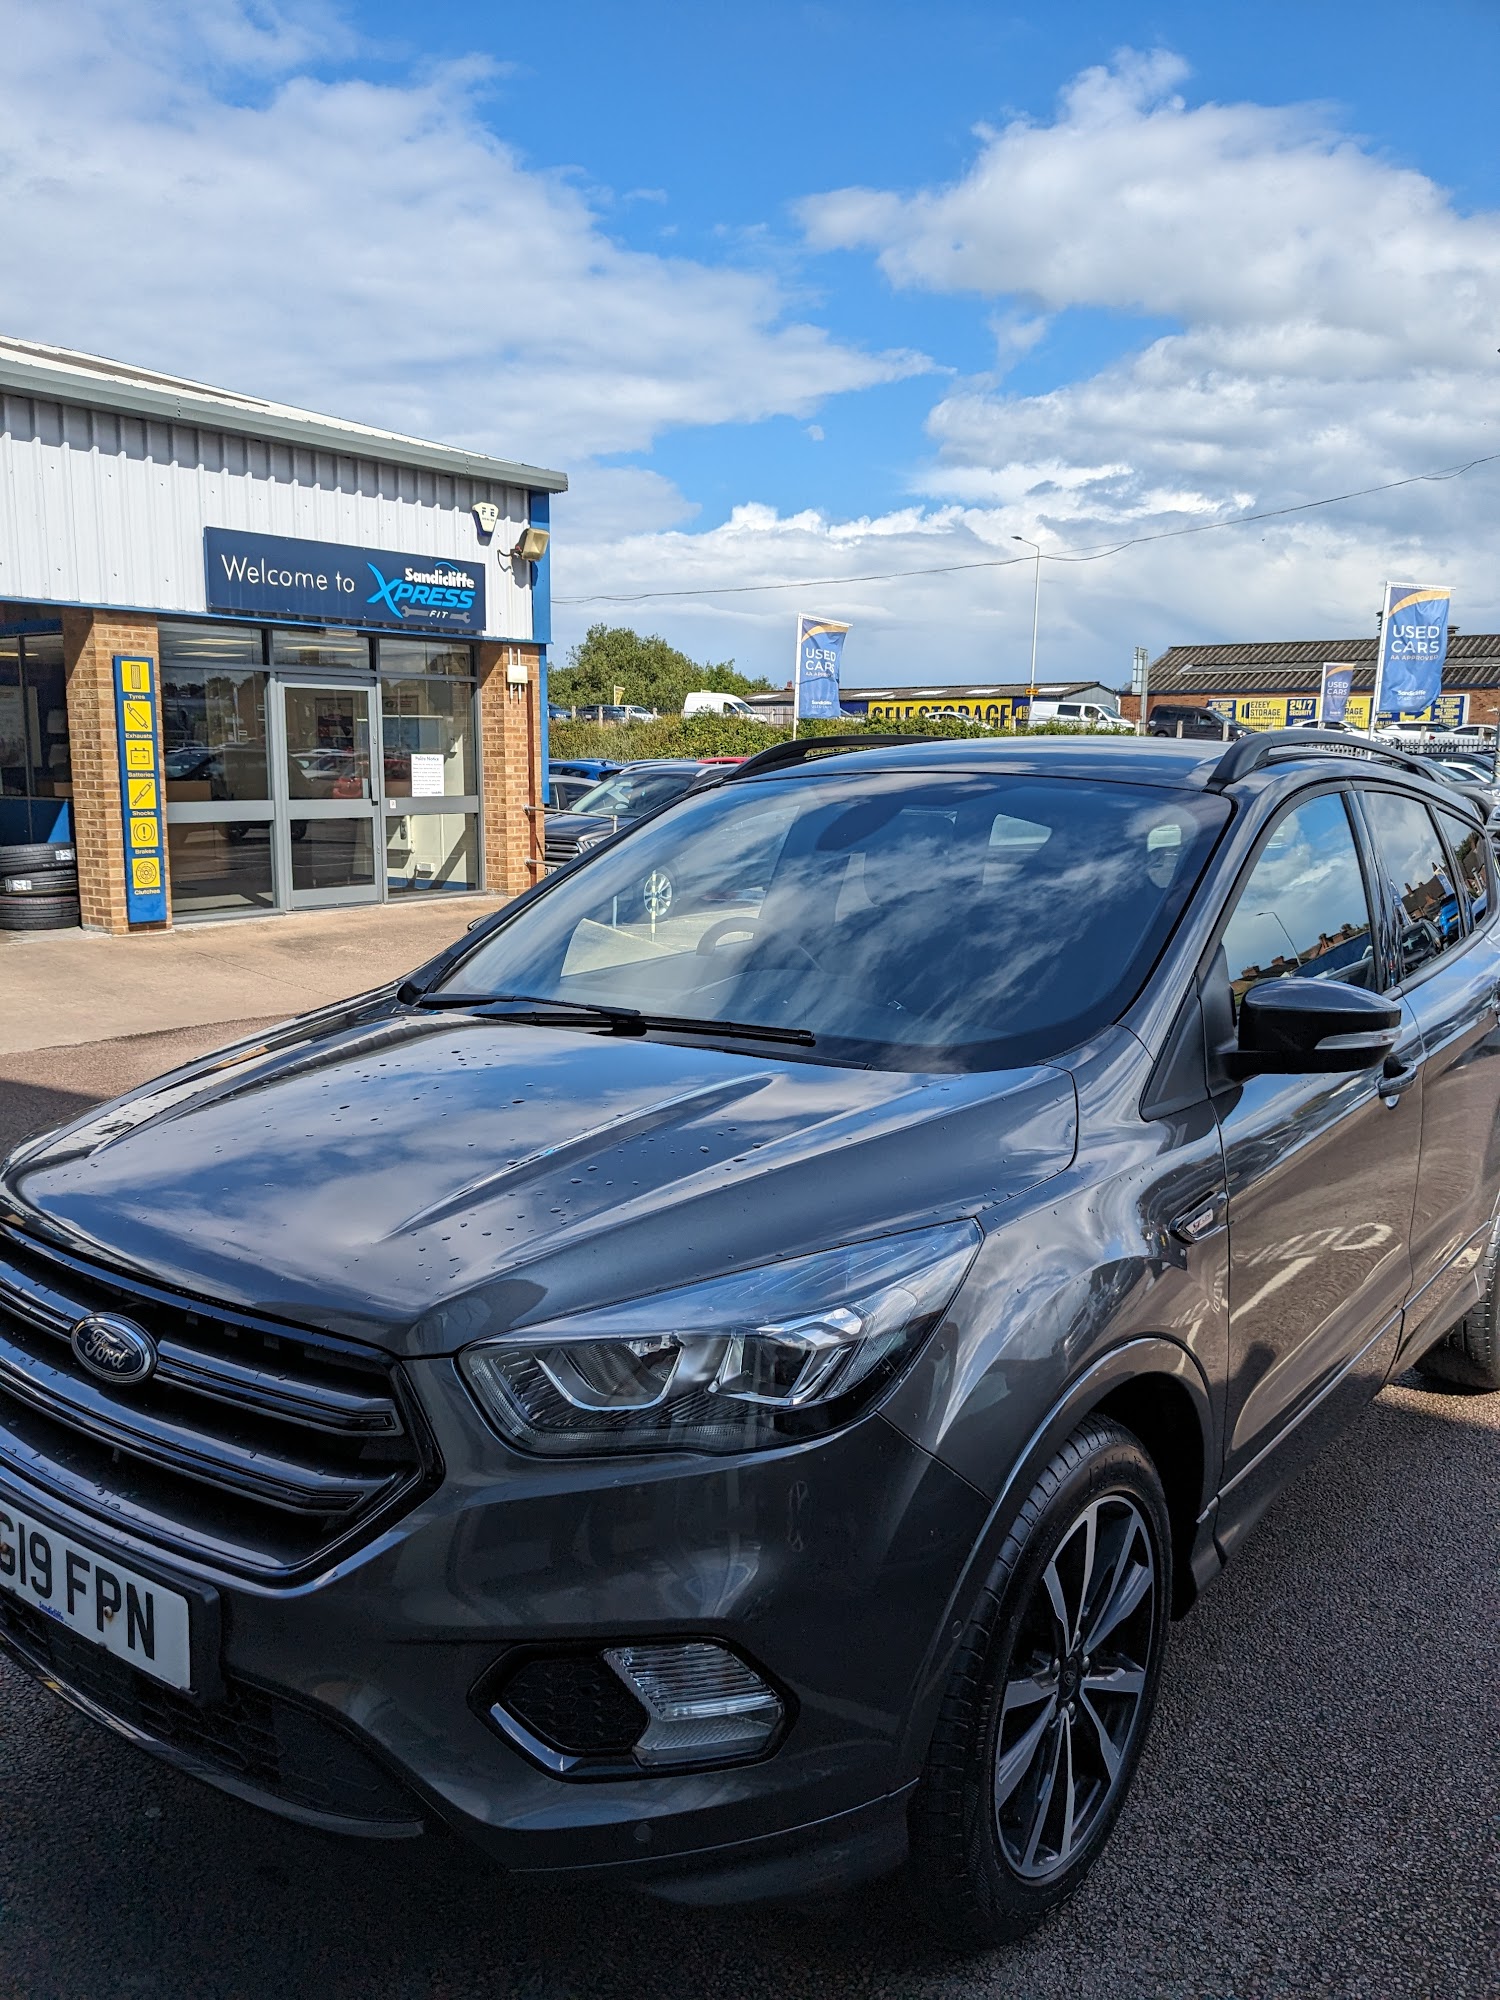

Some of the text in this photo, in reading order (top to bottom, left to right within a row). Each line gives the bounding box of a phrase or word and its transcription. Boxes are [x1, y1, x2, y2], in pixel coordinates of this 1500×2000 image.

[220, 554, 355, 593] Welcome to
[404, 568, 475, 588] Sandicliffe
[366, 562, 476, 619] XPRESS
[429, 610, 448, 619] FIT
[1393, 625, 1440, 639] USED
[805, 647, 836, 661] USED
[1391, 640, 1440, 654] CARS
[805, 660, 835, 674] CARS
[1327, 681, 1349, 689] USED
[1289, 700, 1313, 710] 24/7
[85, 1328, 128, 1369] Ford
[65, 1549, 155, 1661] FPN
